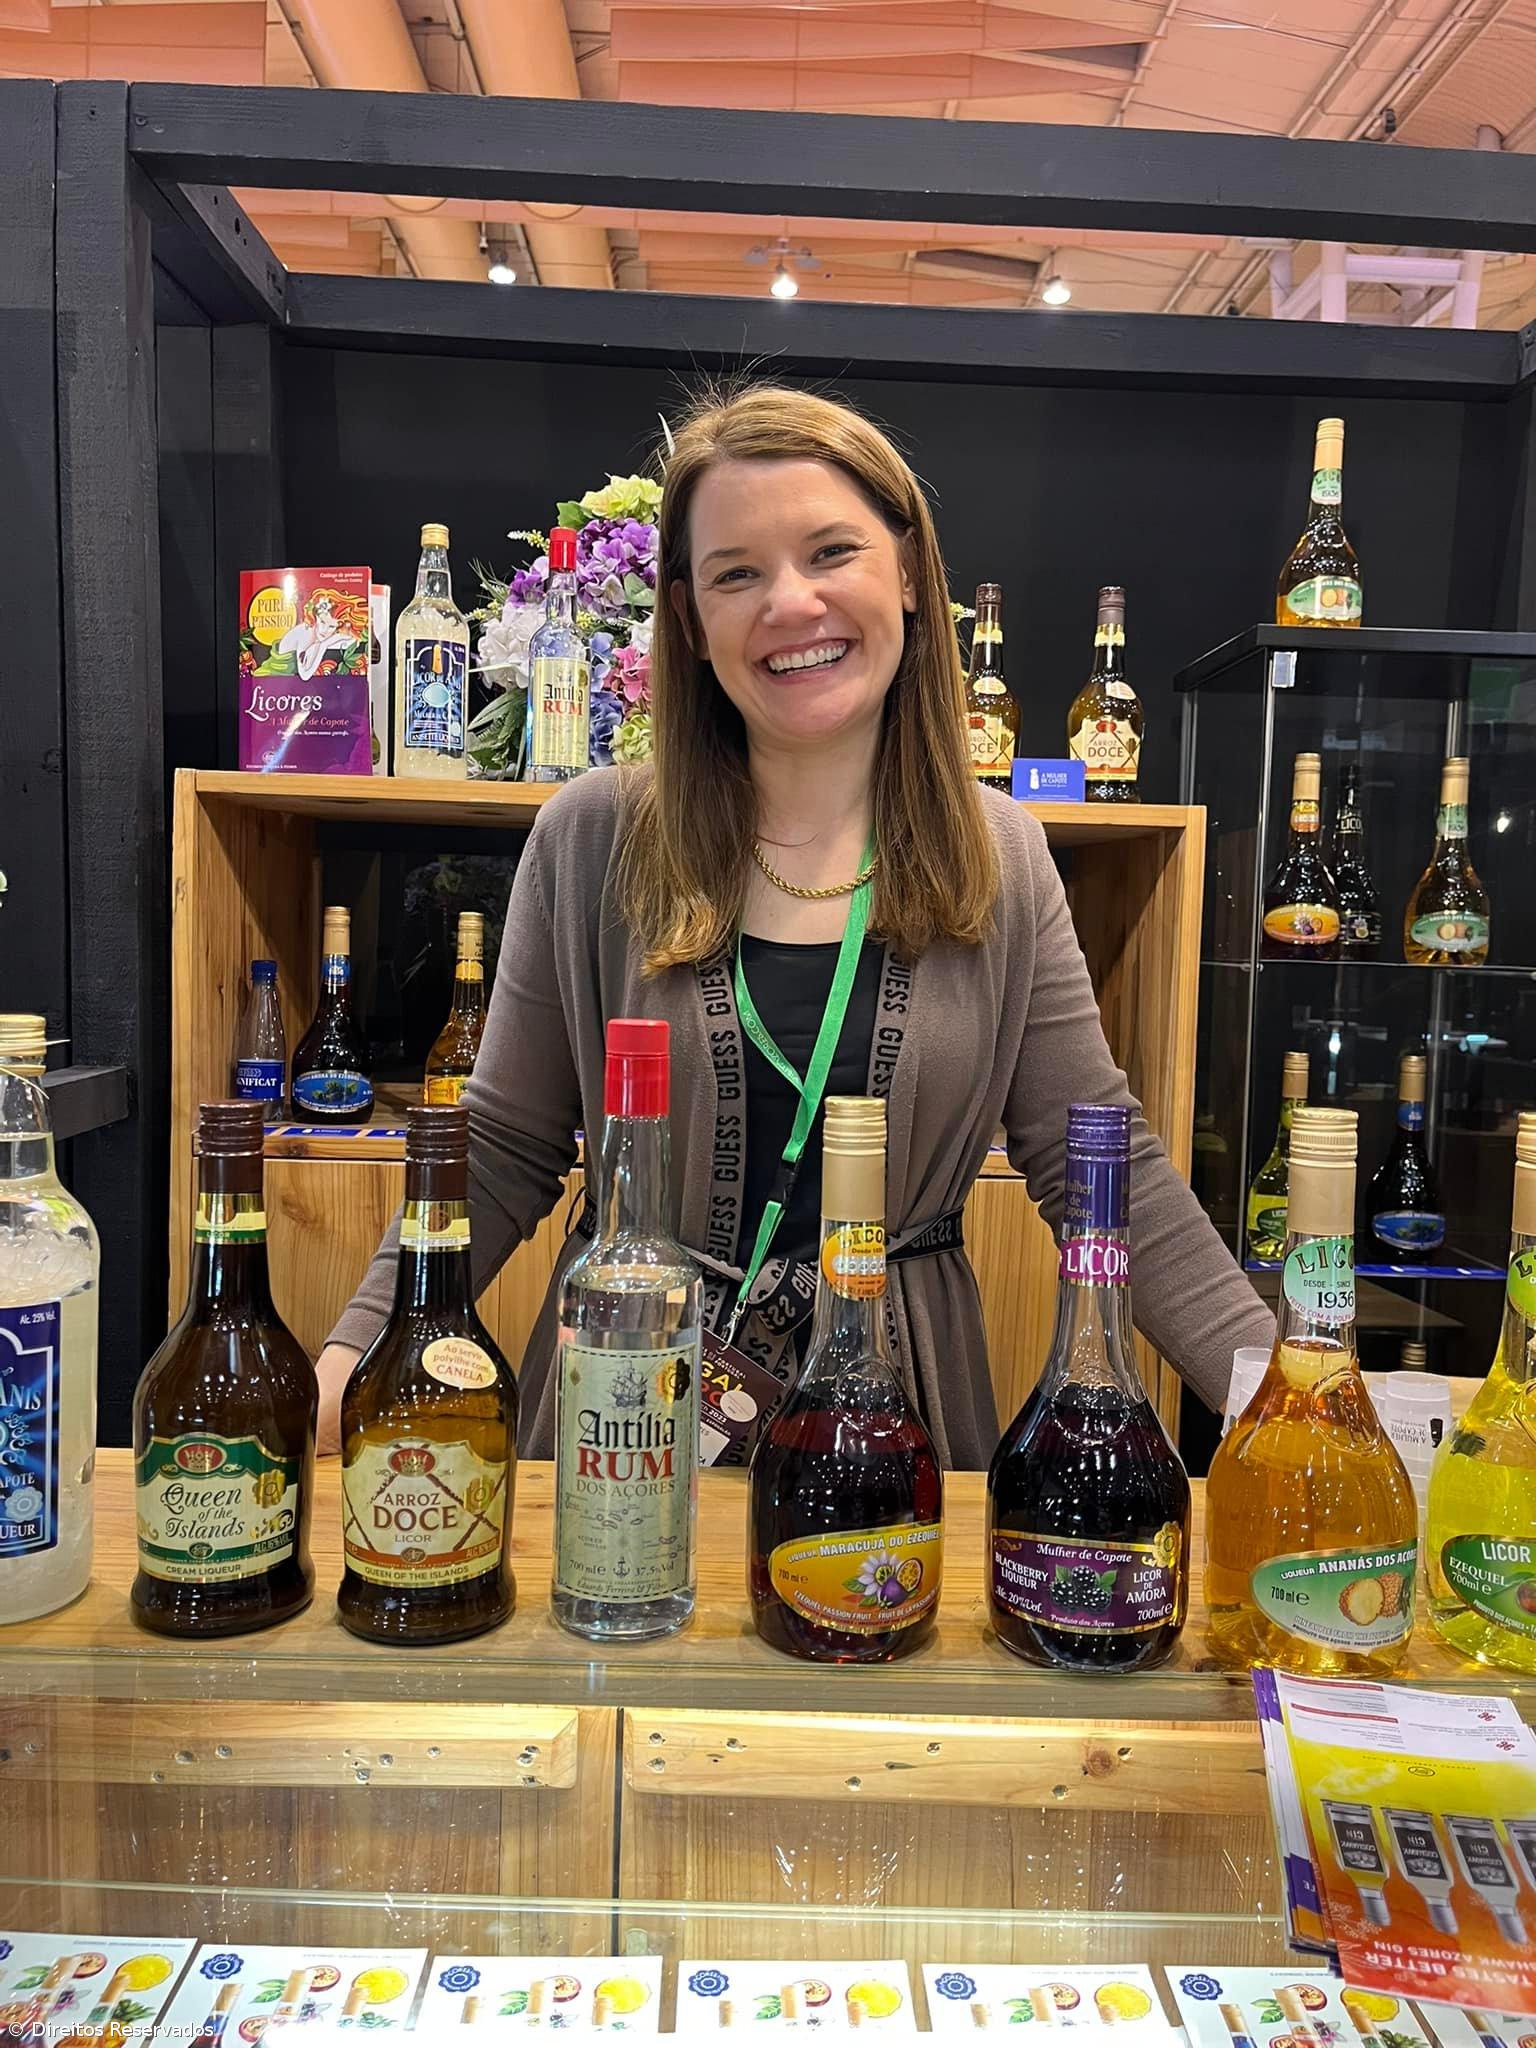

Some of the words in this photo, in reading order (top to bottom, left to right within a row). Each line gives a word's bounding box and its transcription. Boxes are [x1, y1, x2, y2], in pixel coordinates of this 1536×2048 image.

[245, 686, 323, 722] Licores
[543, 700, 584, 716] RUM
[320, 717, 350, 729] Capote
[1087, 746, 1124, 758] DOCE
[710, 1030, 741, 1100] GUESS
[714, 1115, 741, 1183] GUESS
[1066, 1242, 1129, 1277] LICOR
[1303, 1279, 1327, 1288] DESDE
[1317, 1289, 1354, 1309] 1936
[436, 1365, 484, 1383] CANELA
[576, 1445, 676, 1481] RUM
[576, 1479, 607, 1496] DOS
[611, 1479, 676, 1498] AÇORES
[159, 1482, 242, 1515] Queen
[383, 1493, 441, 1506] ARROZ
[198, 1507, 214, 1523] of
[214, 1507, 233, 1519] the
[373, 1504, 459, 1532] DOCE
[164, 1517, 246, 1539] Islands
[394, 1534, 433, 1543] LICOR
[819, 1536, 886, 1557] MARACUJÁ
[888, 1535, 904, 1546] DO
[1036, 1543, 1077, 1559] Mulher
[1079, 1549, 1092, 1561] de
[1094, 1550, 1133, 1565] Capote
[1480, 1541, 1532, 1564] LICOR
[166, 1566, 197, 1576] CREAM
[198, 1564, 242, 1575] LIQUEUR
[364, 1567, 392, 1579] QUEEN
[393, 1572, 407, 1580] OF
[409, 1571, 426, 1580] THE
[429, 1565, 470, 1579] ISLANDS
[568, 1559, 585, 1572] 700
[778, 1568, 790, 1581] 700
[995, 1552, 1049, 1582] BLACKBERRY
[1280, 1567, 1315, 1580] LIQUEUR
[1318, 1555, 1373, 1574] ANANÁS
[1375, 1552, 1396, 1567] DOS
[1449, 1556, 1506, 1586] EZEQUIEL
[1000, 1566, 1037, 1591] LIQUEUR
[1132, 1568, 1163, 1584] LICOR
[1452, 1571, 1480, 1592] 700ml
[1125, 1586, 1168, 1604] AMORA
[1143, 1582, 1153, 1591] DE
[1271, 1586, 1285, 1601] 700
[1285, 1591, 1295, 1604] ml
[1296, 1592, 1311, 1606] e
[822, 1604, 851, 1619] PASSION
[852, 1611, 872, 1620] FRUIT
[1050, 1614, 1076, 1625] Produto
[1077, 1618, 1091, 1627] dos
[1091, 1618, 1115, 1628] Açores
[1373, 1939, 1403, 1954] GIN
[1407, 1944, 1472, 1963] AZORES
[1364, 1950, 1447, 1975] BETTER
[1452, 1964, 1534, 1988] TASTES
